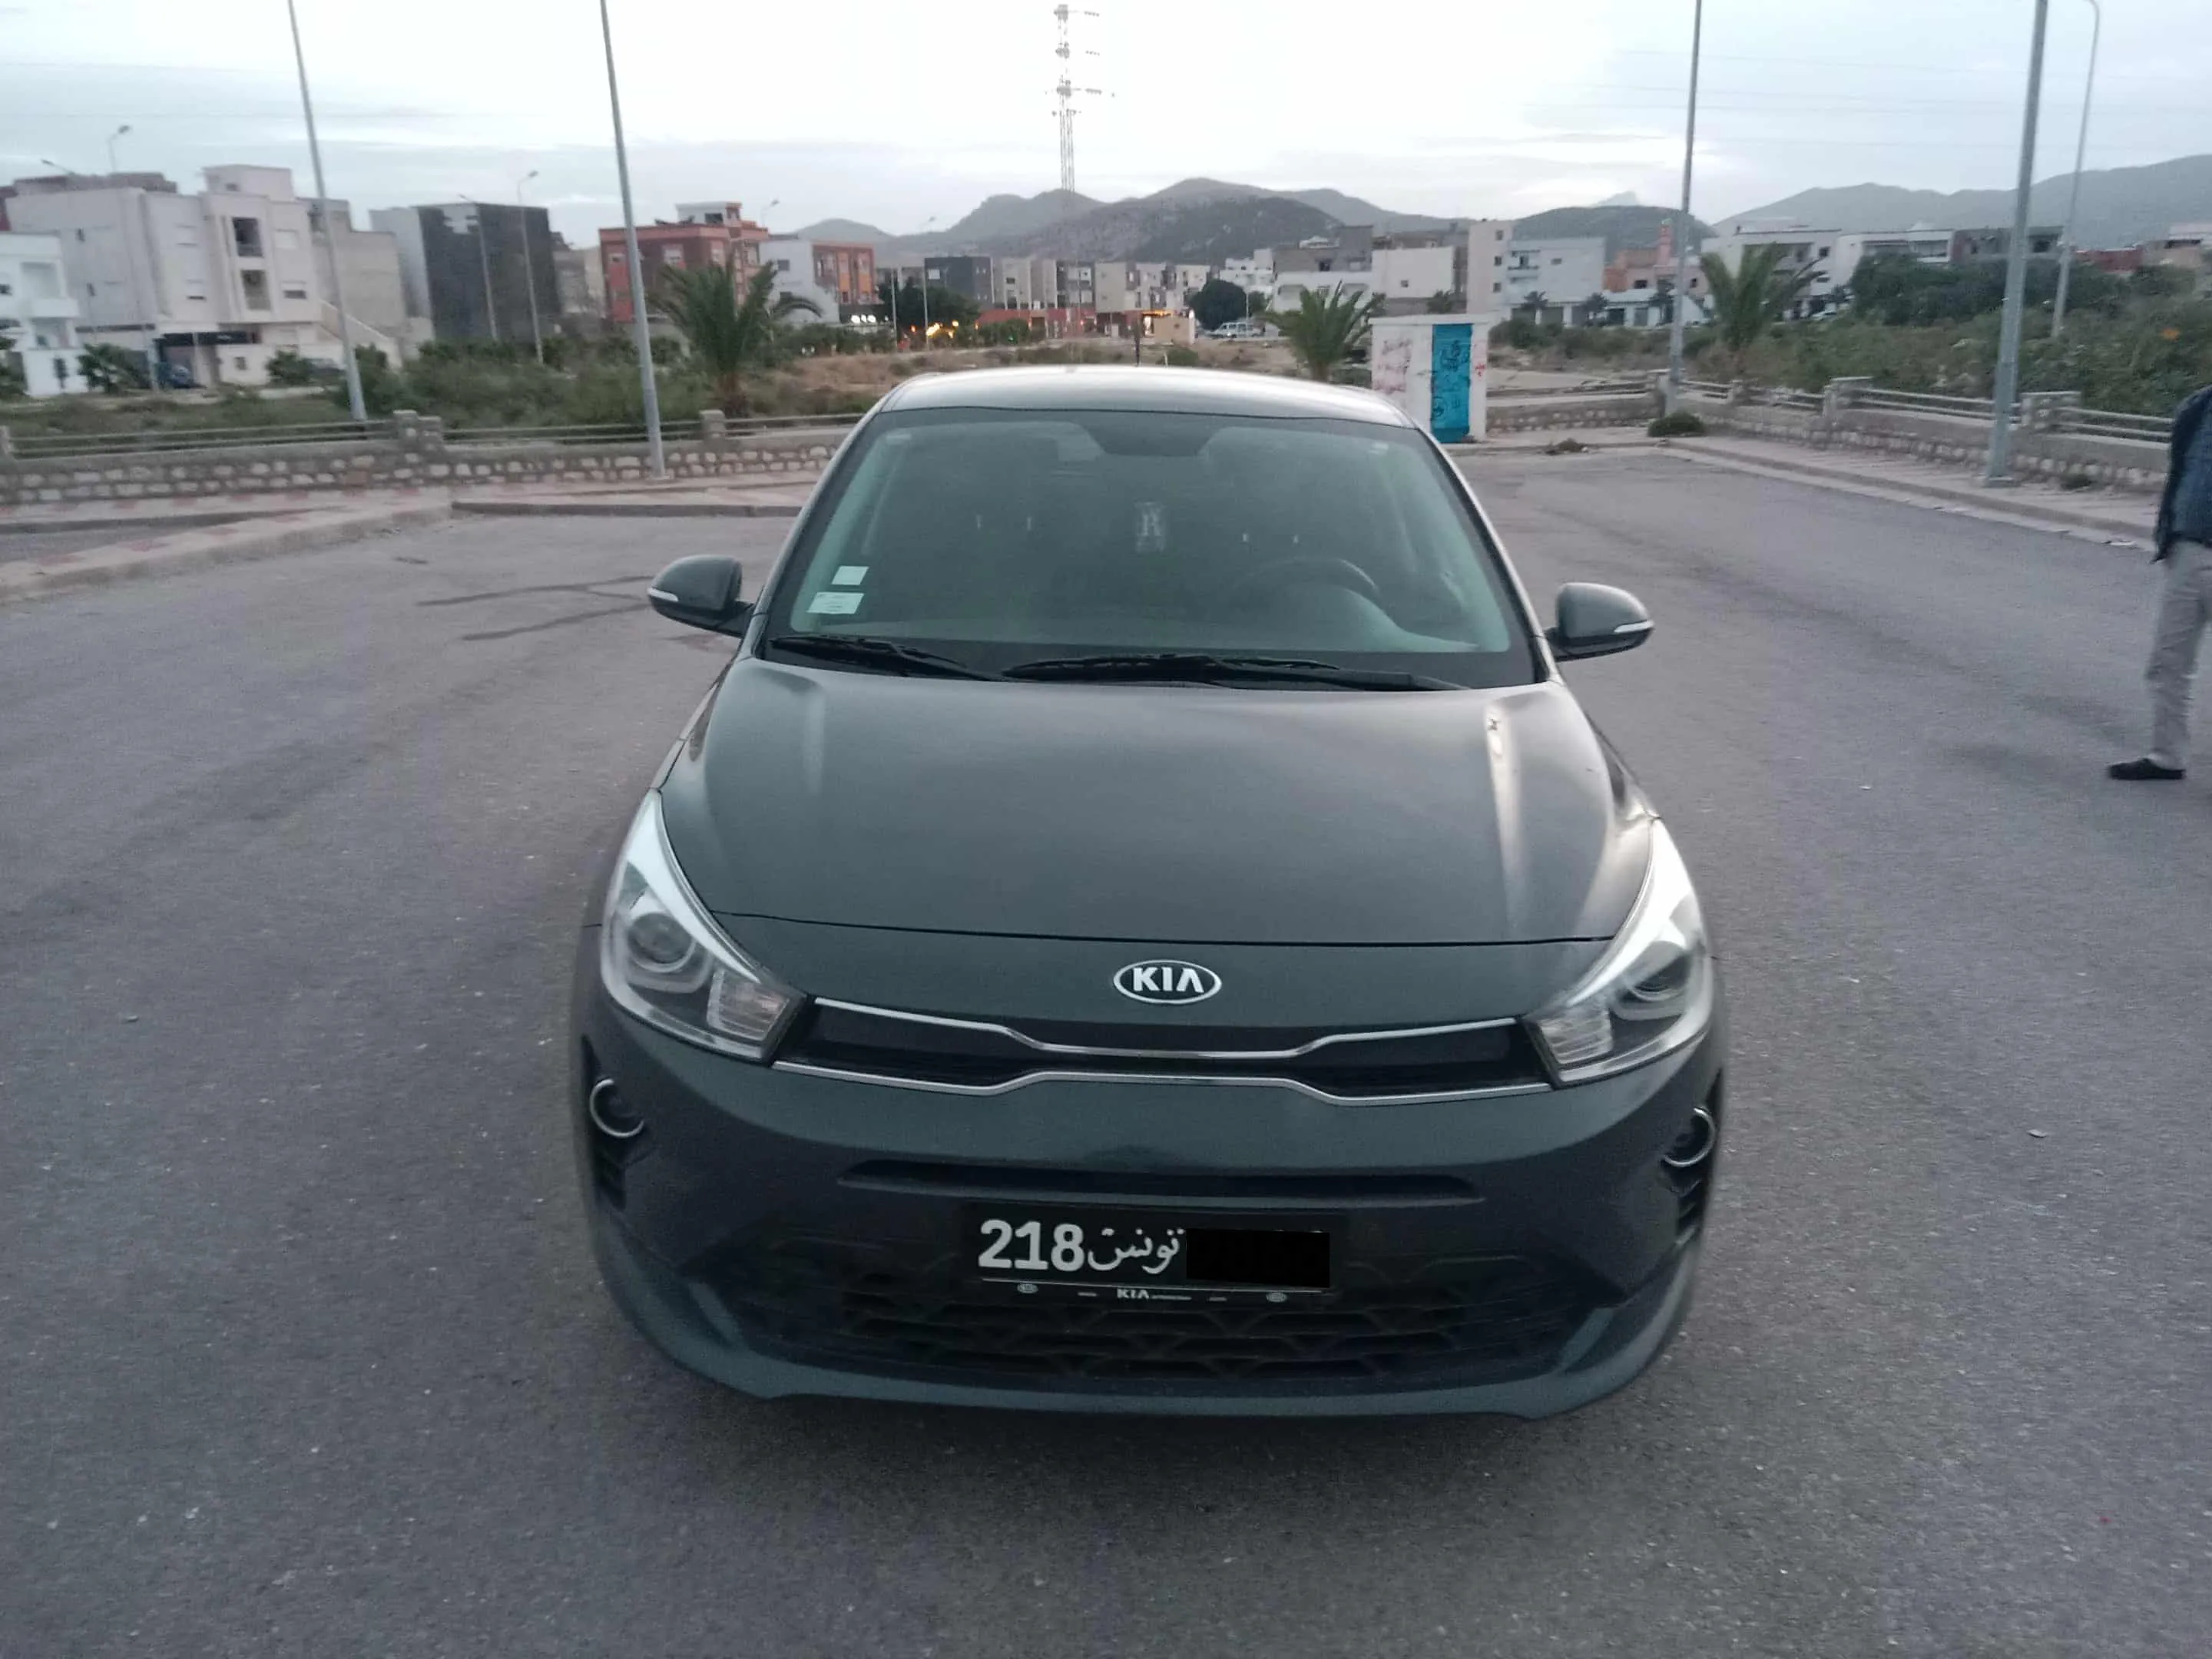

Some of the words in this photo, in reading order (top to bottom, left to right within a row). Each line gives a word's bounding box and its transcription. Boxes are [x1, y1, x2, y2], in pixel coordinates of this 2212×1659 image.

[1133, 966, 1204, 993] KIA
[978, 1219, 1085, 1272] 218
[1088, 1227, 1184, 1275] تونس
[1117, 1286, 1151, 1300] KIA
